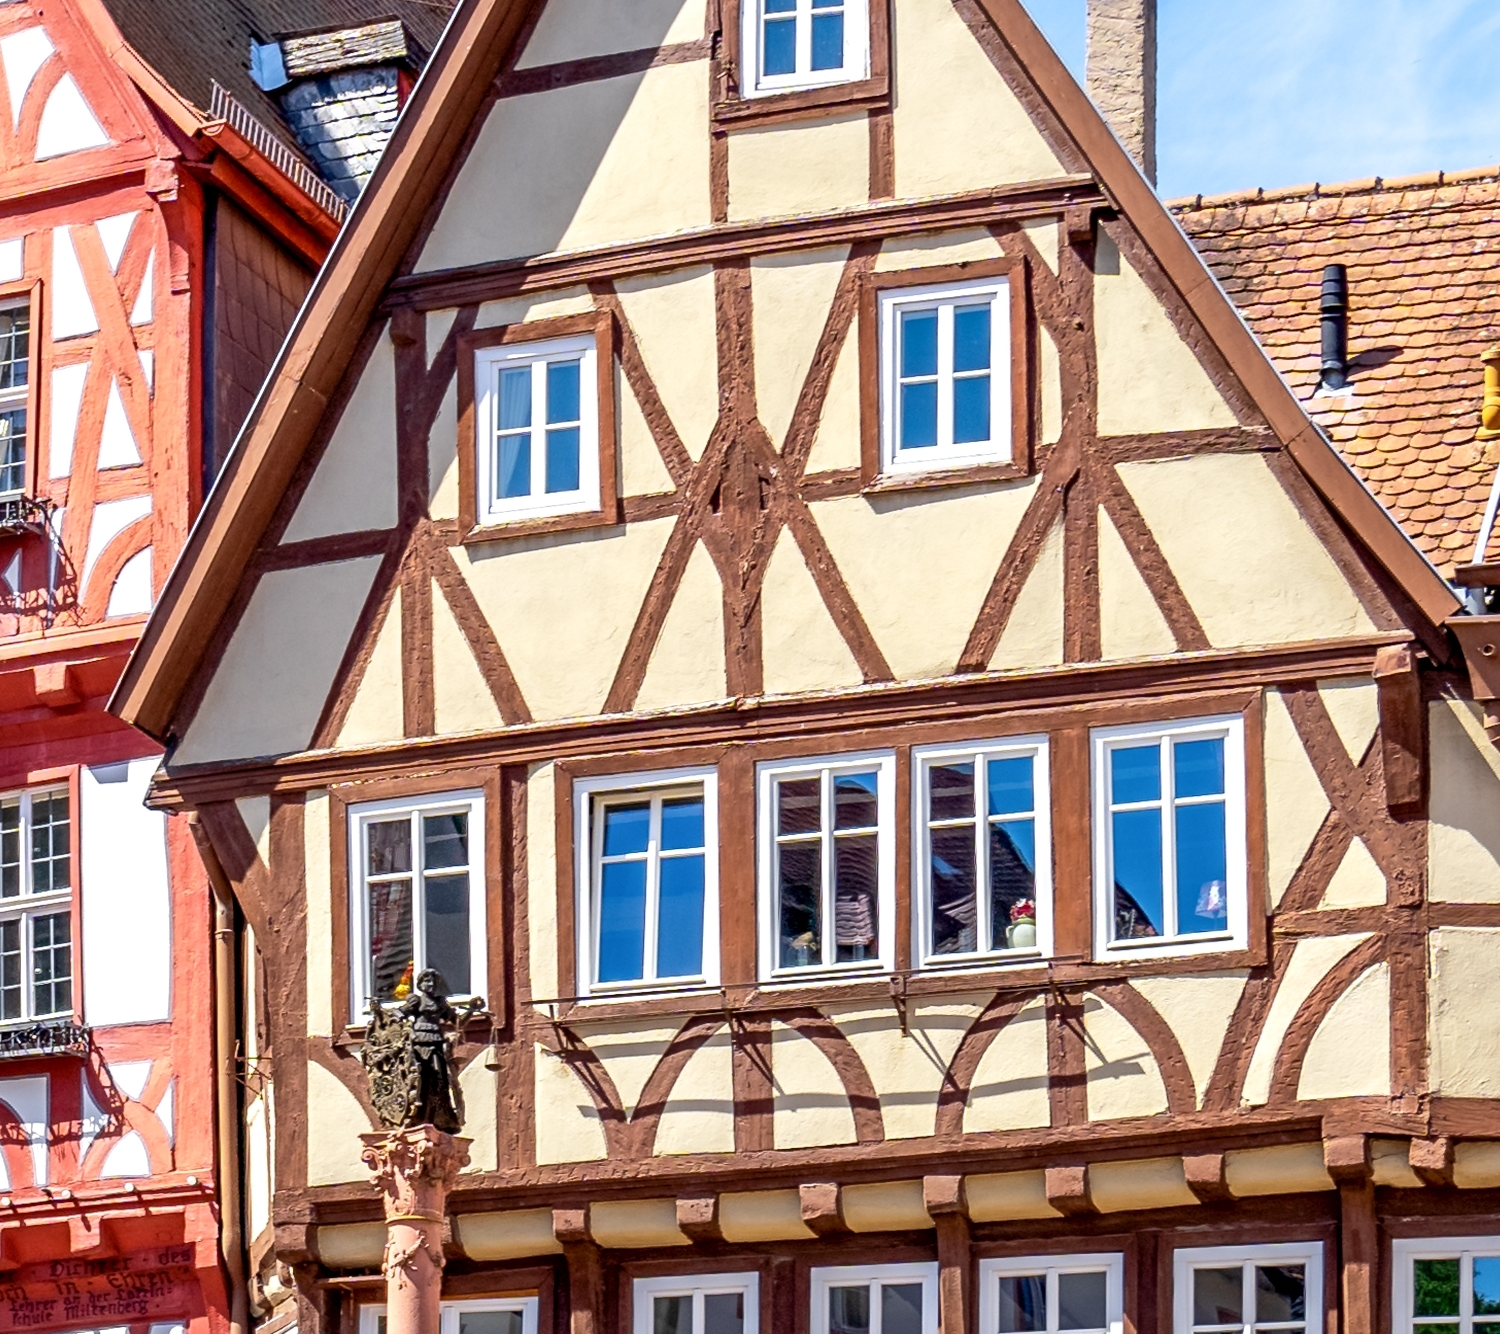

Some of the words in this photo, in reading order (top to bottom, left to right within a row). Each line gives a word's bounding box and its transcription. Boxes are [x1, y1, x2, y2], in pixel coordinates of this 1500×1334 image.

[157, 1246, 192, 1266] des
[9, 1299, 58, 1313] Lehrer
[86, 1290, 111, 1304] der
